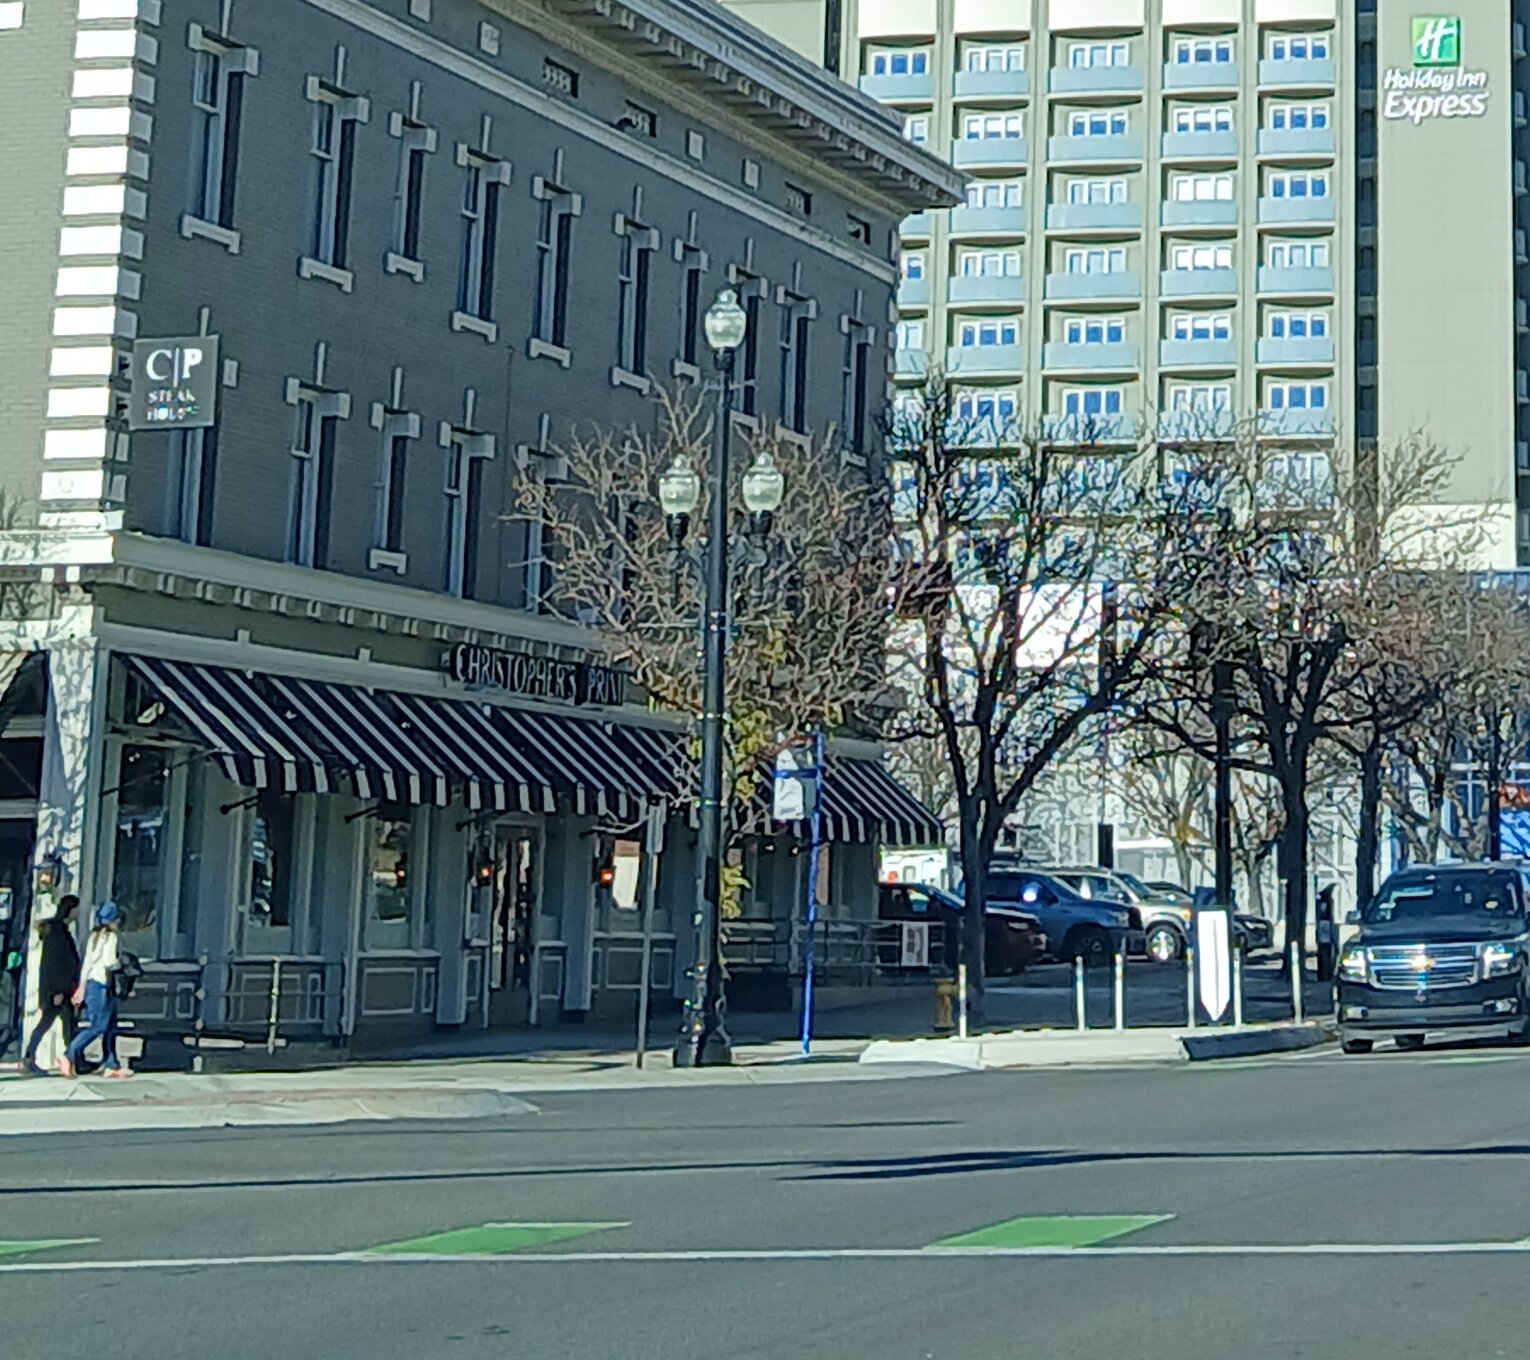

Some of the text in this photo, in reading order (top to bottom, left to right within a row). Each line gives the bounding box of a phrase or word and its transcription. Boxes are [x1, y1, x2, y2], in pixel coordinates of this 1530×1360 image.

[1384, 67, 1487, 91] Holiday Inn
[1384, 91, 1490, 124] Express
